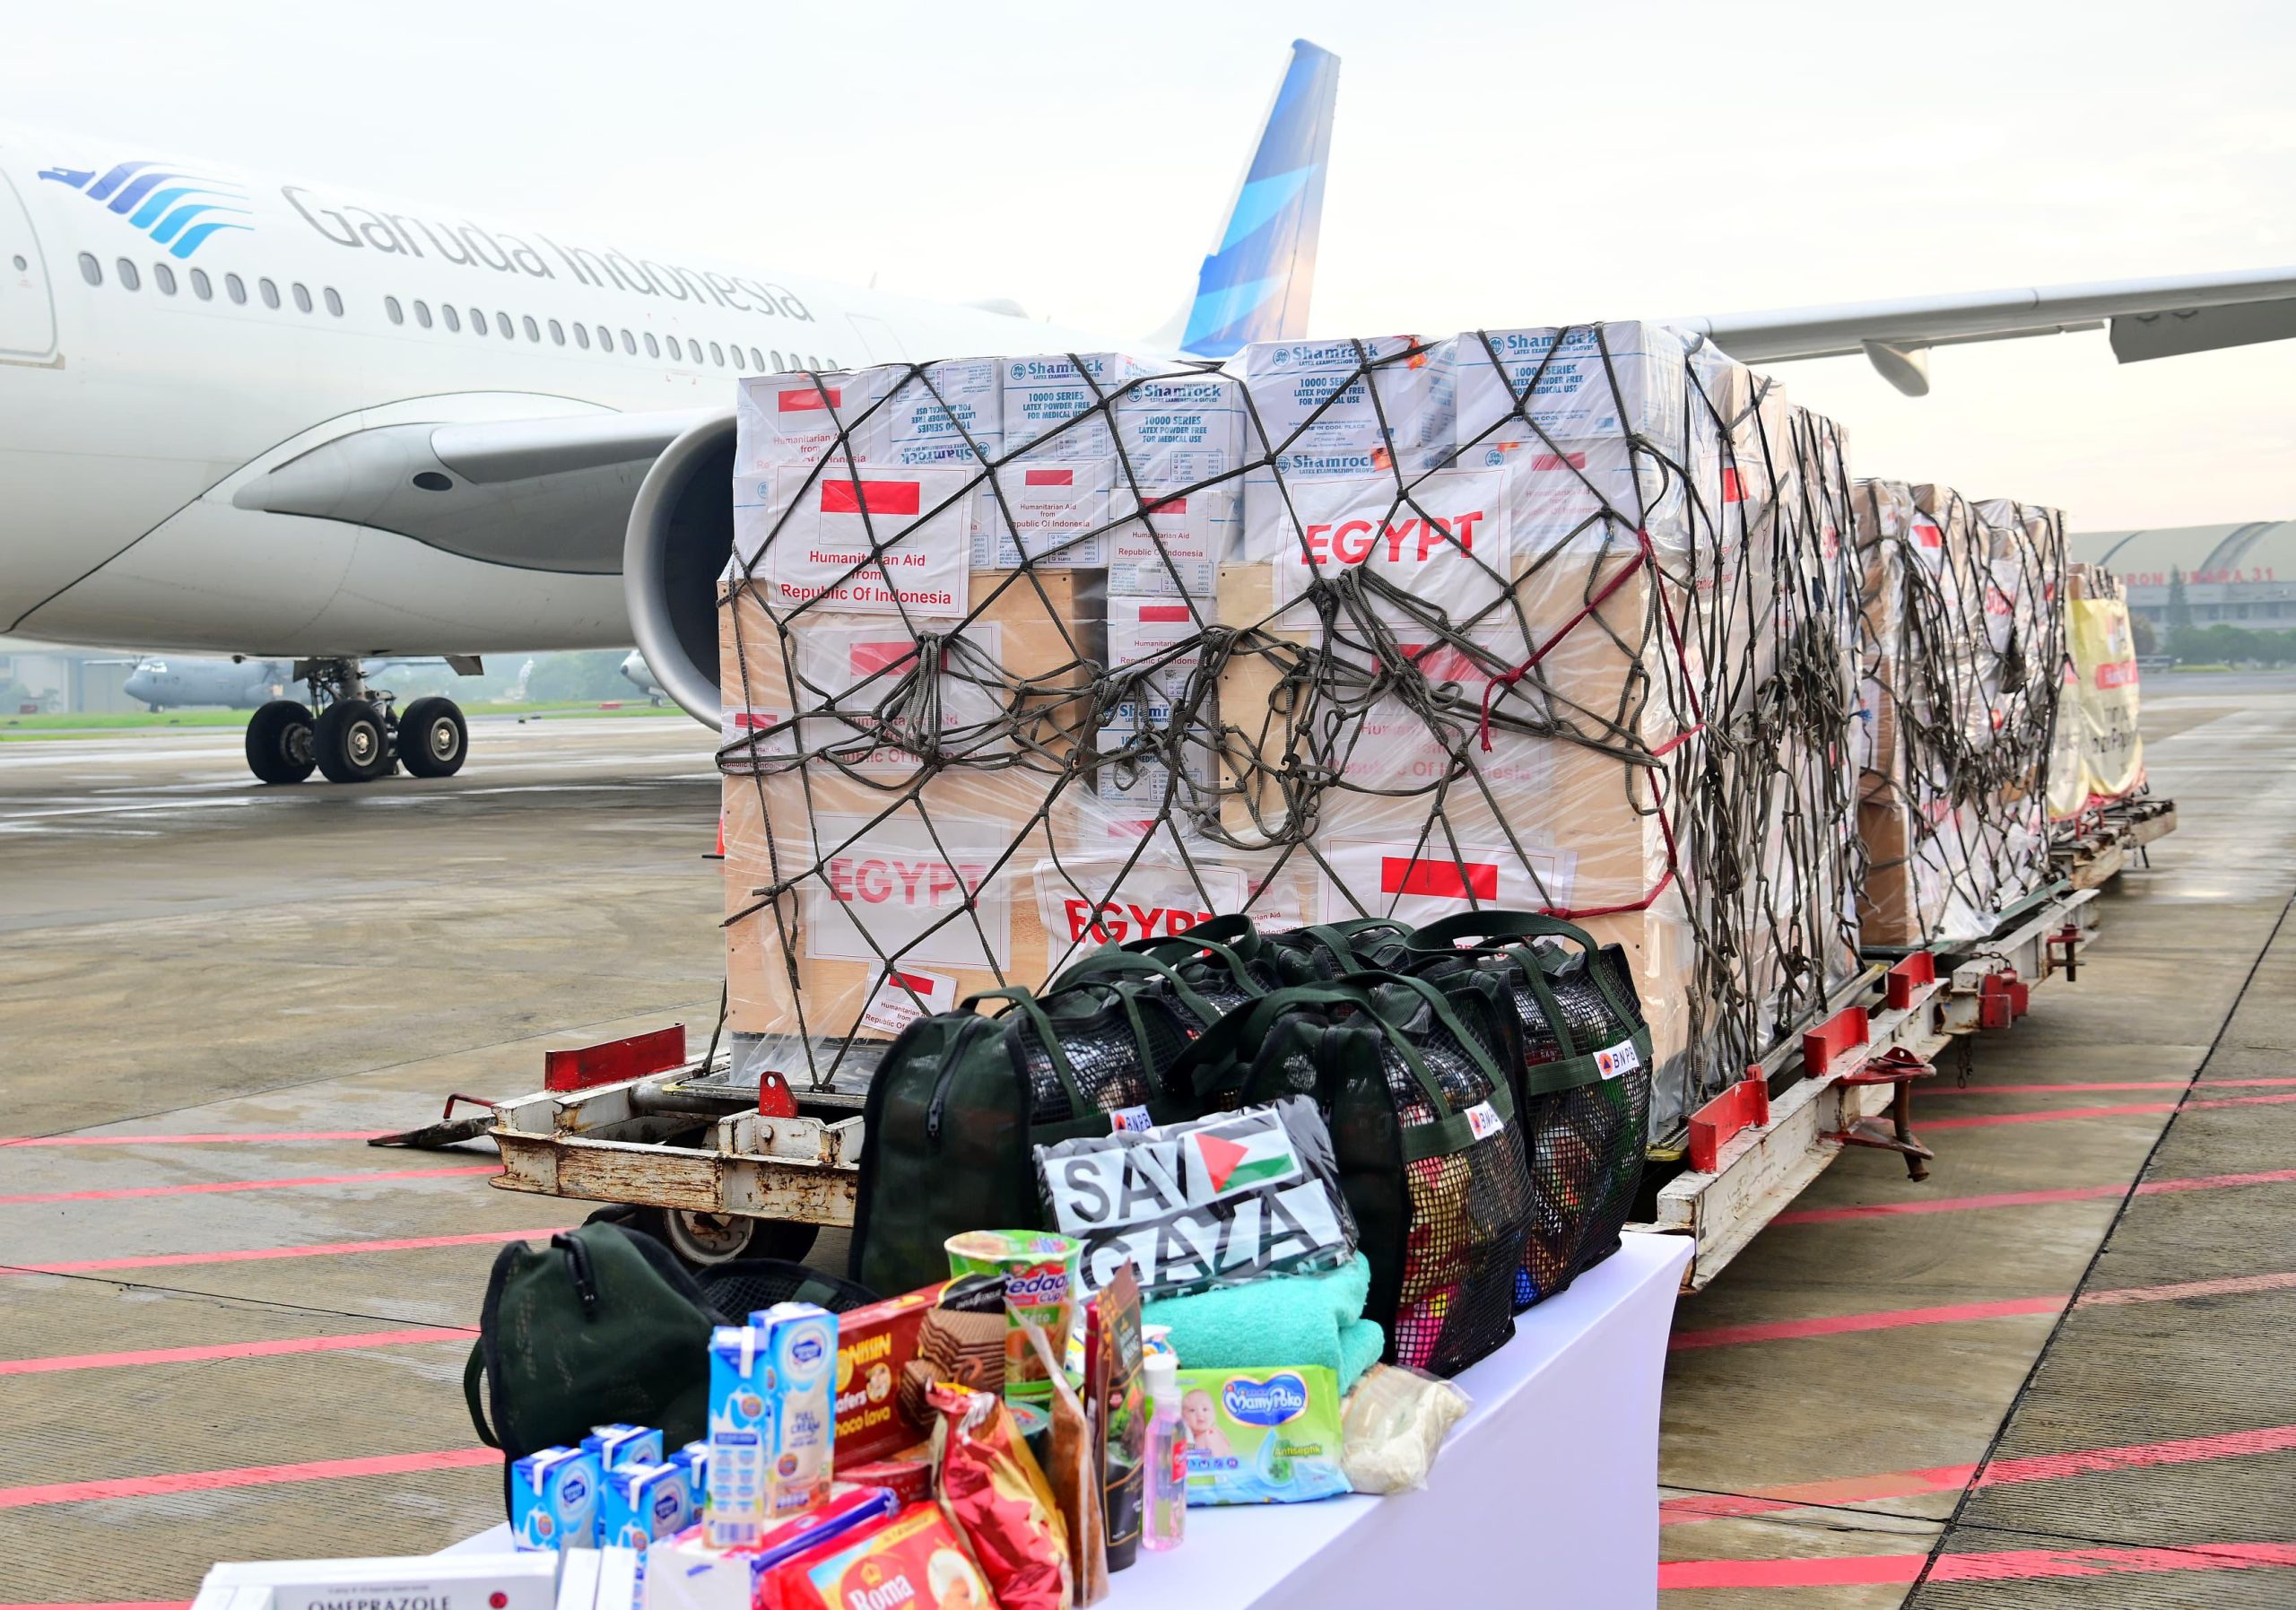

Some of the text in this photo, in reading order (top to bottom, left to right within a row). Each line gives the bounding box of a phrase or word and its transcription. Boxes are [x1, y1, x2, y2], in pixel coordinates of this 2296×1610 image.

[281, 186, 815, 323] Garuda Indonesia
[1292, 344, 1378, 359] Shamrok
[1531, 346, 1572, 354] EXAMIATION
[1028, 359, 1103, 374] Shamrck
[1515, 364, 1577, 377] 1000 SERIES
[1300, 377, 1359, 387] 10000 SERS
[1536, 376, 1563, 386] OWDER
[1566, 375, 1584, 383] FREE
[1029, 391, 1084, 403] 10000 SERIES
[1144, 384, 1221, 397] Shamrock
[1293, 387, 1365, 397] LATEX POWDR FREE
[1022, 404, 1042, 412] LATEX
[1043, 402, 1073, 411] POWDER
[1299, 396, 1360, 405] FOR MEDAL USE
[929, 405, 957, 413] MEICAL
[1027, 412, 1040, 420] FOR
[1041, 411, 1071, 419] MEDICAL
[911, 412, 976, 423] LATEX OWDER FREE
[1144, 415, 1202, 425] 10000 SERIES
[918, 422, 970, 433] 1000 SERIES
[1138, 426, 1207, 434] LATEX POWDER FREE
[773, 433, 831, 445] Humanitarian
[1143, 435, 1202, 443] FOR MEDICAL USE
[800, 445, 821, 453] from
[817, 455, 866, 464] Idonsia
[900, 448, 973, 464] Shamrock
[1011, 520, 1039, 529] epublic
[1132, 531, 1177, 539] Humatarian
[1300, 511, 1483, 566] EGYPT
[1118, 547, 1152, 556] Republic
[1166, 549, 1204, 557] ndonesia
[810, 551, 926, 567] Humanitan Aid
[2253, 567, 2274, 582] 31
[780, 583, 952, 605] Republic Of Indonesia
[1120, 657, 1155, 665] Replic
[1172, 657, 1197, 665] ndone
[888, 748, 907, 762] Of
[1413, 761, 1436, 777] Of
[1440, 762, 1533, 780] Inesia
[830, 857, 986, 909] EGYPT
[881, 1001, 920, 1017] Humanitarian
[865, 1014, 906, 1030] Republic Of
[897, 1013, 911, 1022] from
[1613, 1046, 1636, 1069] BNPB
[1126, 1113, 1151, 1131] BNPB
[1064, 1146, 1188, 1223] SAV
[1078, 1182, 1320, 1294] GAZA
[1039, 1292, 1061, 1302] Cup
[835, 1389, 867, 1414] afers
[1224, 1386, 1303, 1414] MamyPoko
[834, 1405, 891, 1439] hoco lava
[1274, 1442, 1323, 1458] Antiseptik
[848, 1574, 916, 1610] Roma
[308, 1595, 452, 1610] OMEPRAZOLE
